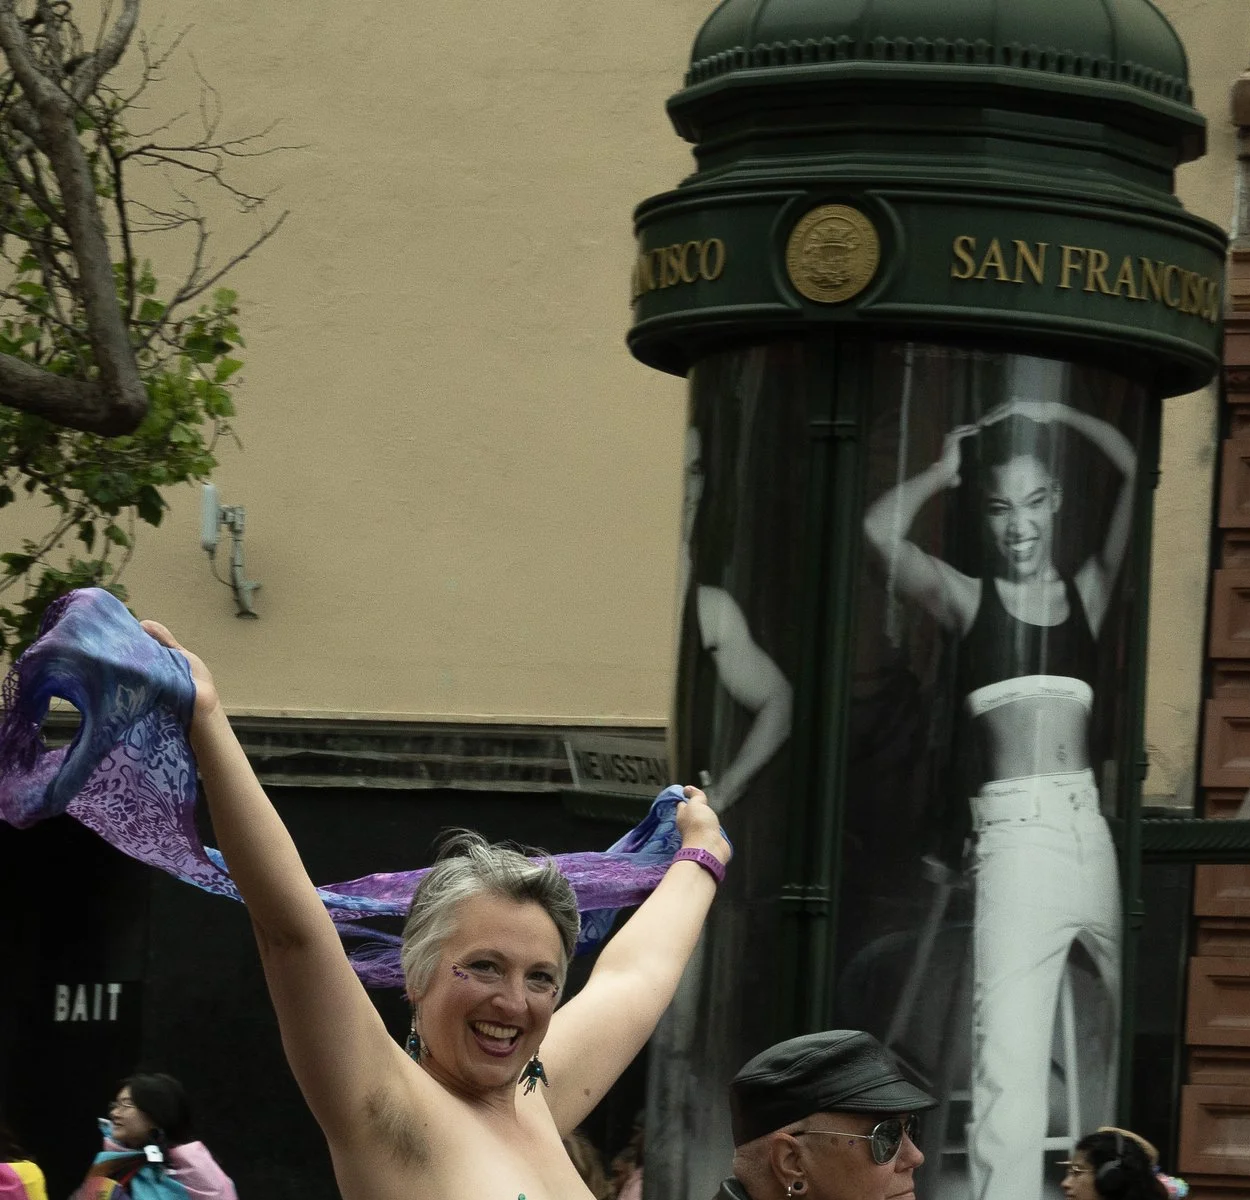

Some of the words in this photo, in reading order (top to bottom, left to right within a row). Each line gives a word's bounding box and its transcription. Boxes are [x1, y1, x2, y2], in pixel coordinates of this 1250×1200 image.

[632, 238, 726, 296] NCISCO
[951, 236, 1050, 285] SAN
[54, 983, 122, 1022] BAIT
